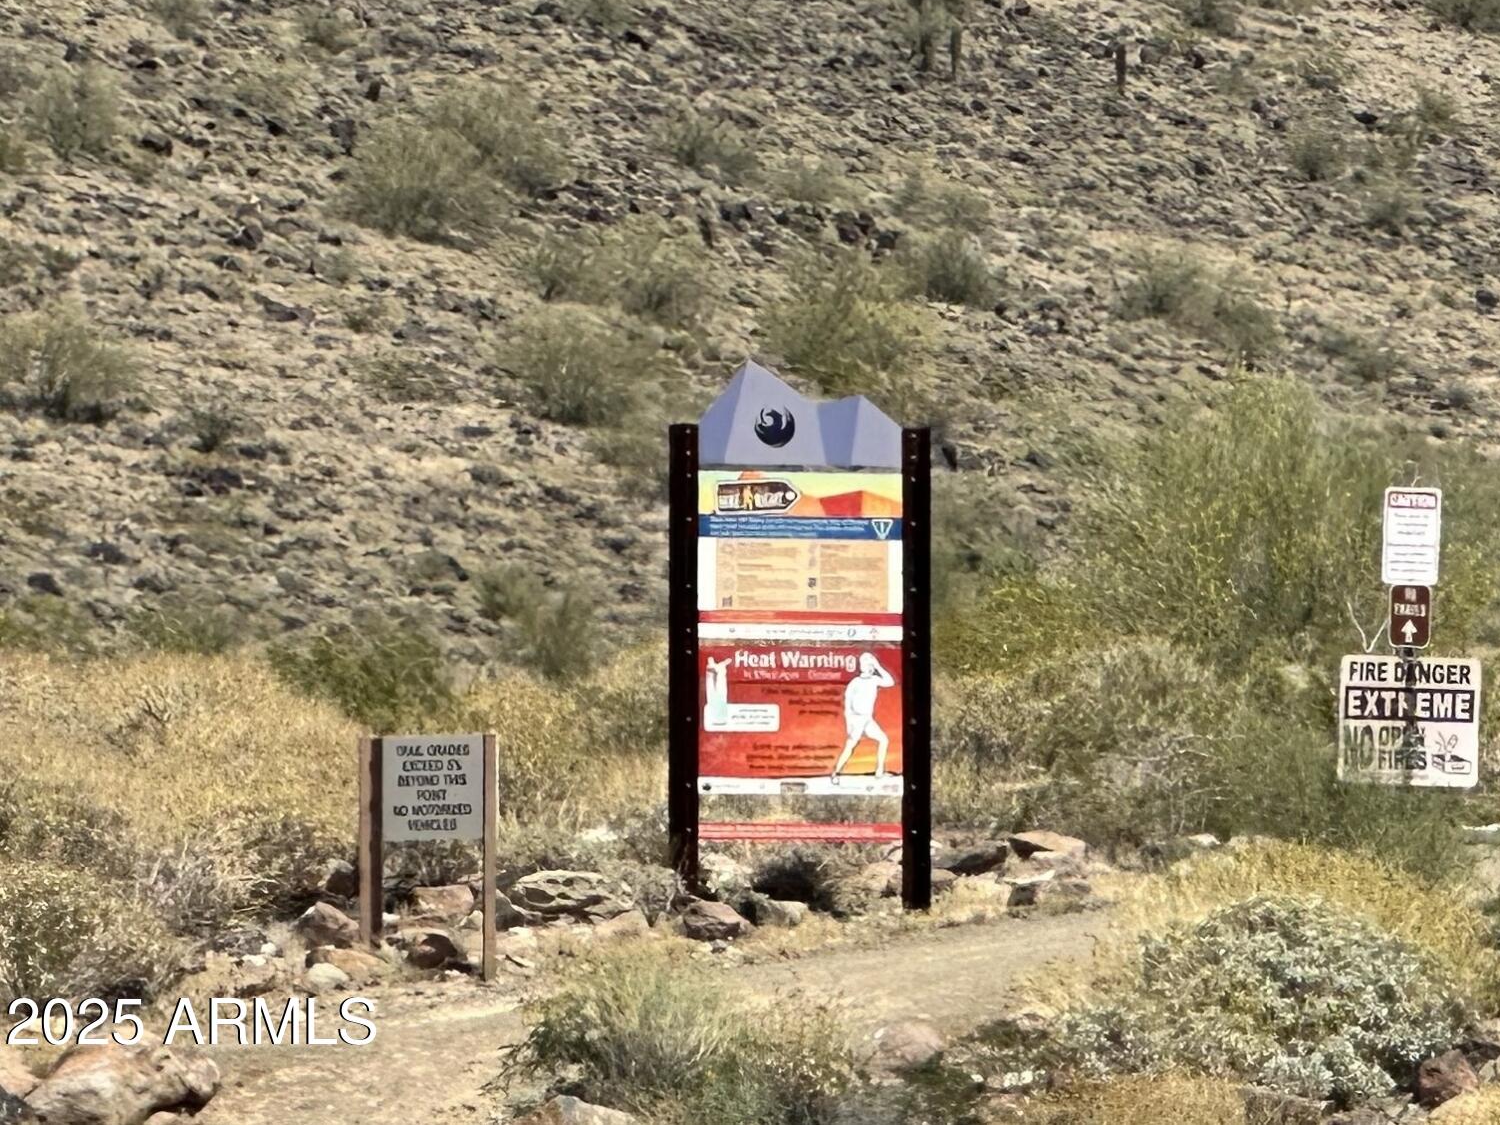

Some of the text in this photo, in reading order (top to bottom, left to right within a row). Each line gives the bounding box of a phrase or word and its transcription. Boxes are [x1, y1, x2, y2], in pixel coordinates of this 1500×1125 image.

[735, 650, 856, 672] Heat Warning
[1349, 661, 1471, 685] FIRE DNGER
[398, 774, 467, 787] BEYOND THIS
[417, 789, 447, 801] POINT
